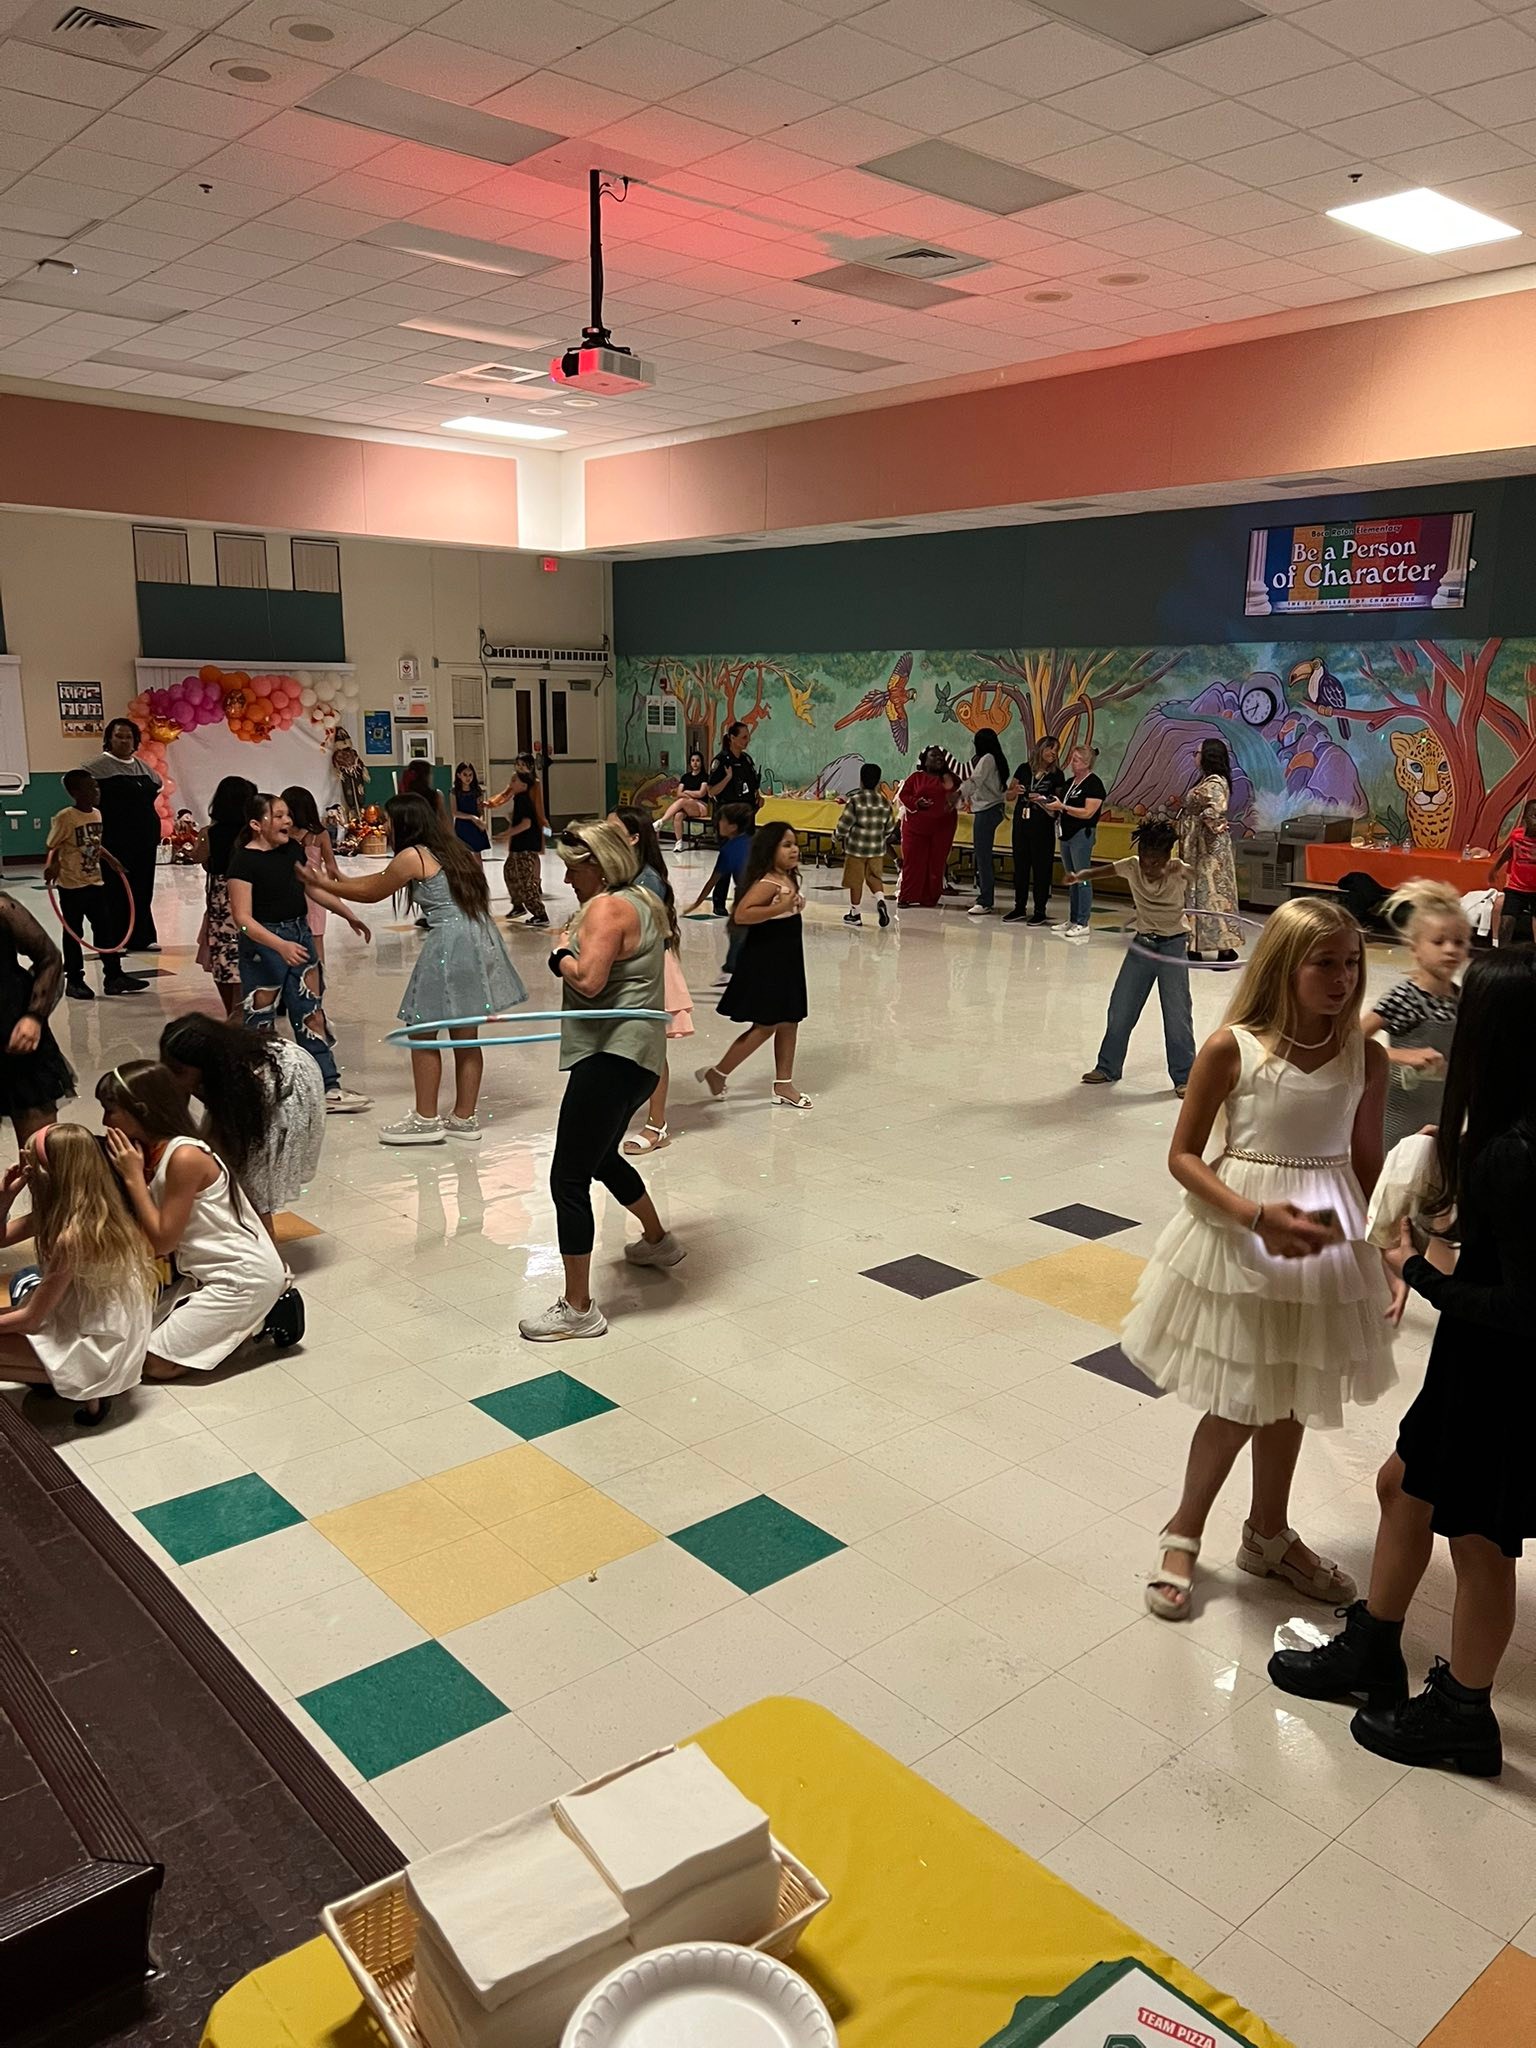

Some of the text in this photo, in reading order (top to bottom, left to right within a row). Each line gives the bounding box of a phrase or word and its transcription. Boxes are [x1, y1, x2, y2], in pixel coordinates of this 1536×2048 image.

[1356, 524, 1402, 534] Elementary
[1293, 539, 1417, 562] Be a Person
[1272, 562, 1437, 589] of Character
[1140, 2009, 1214, 2048] TEAM PIZZA
